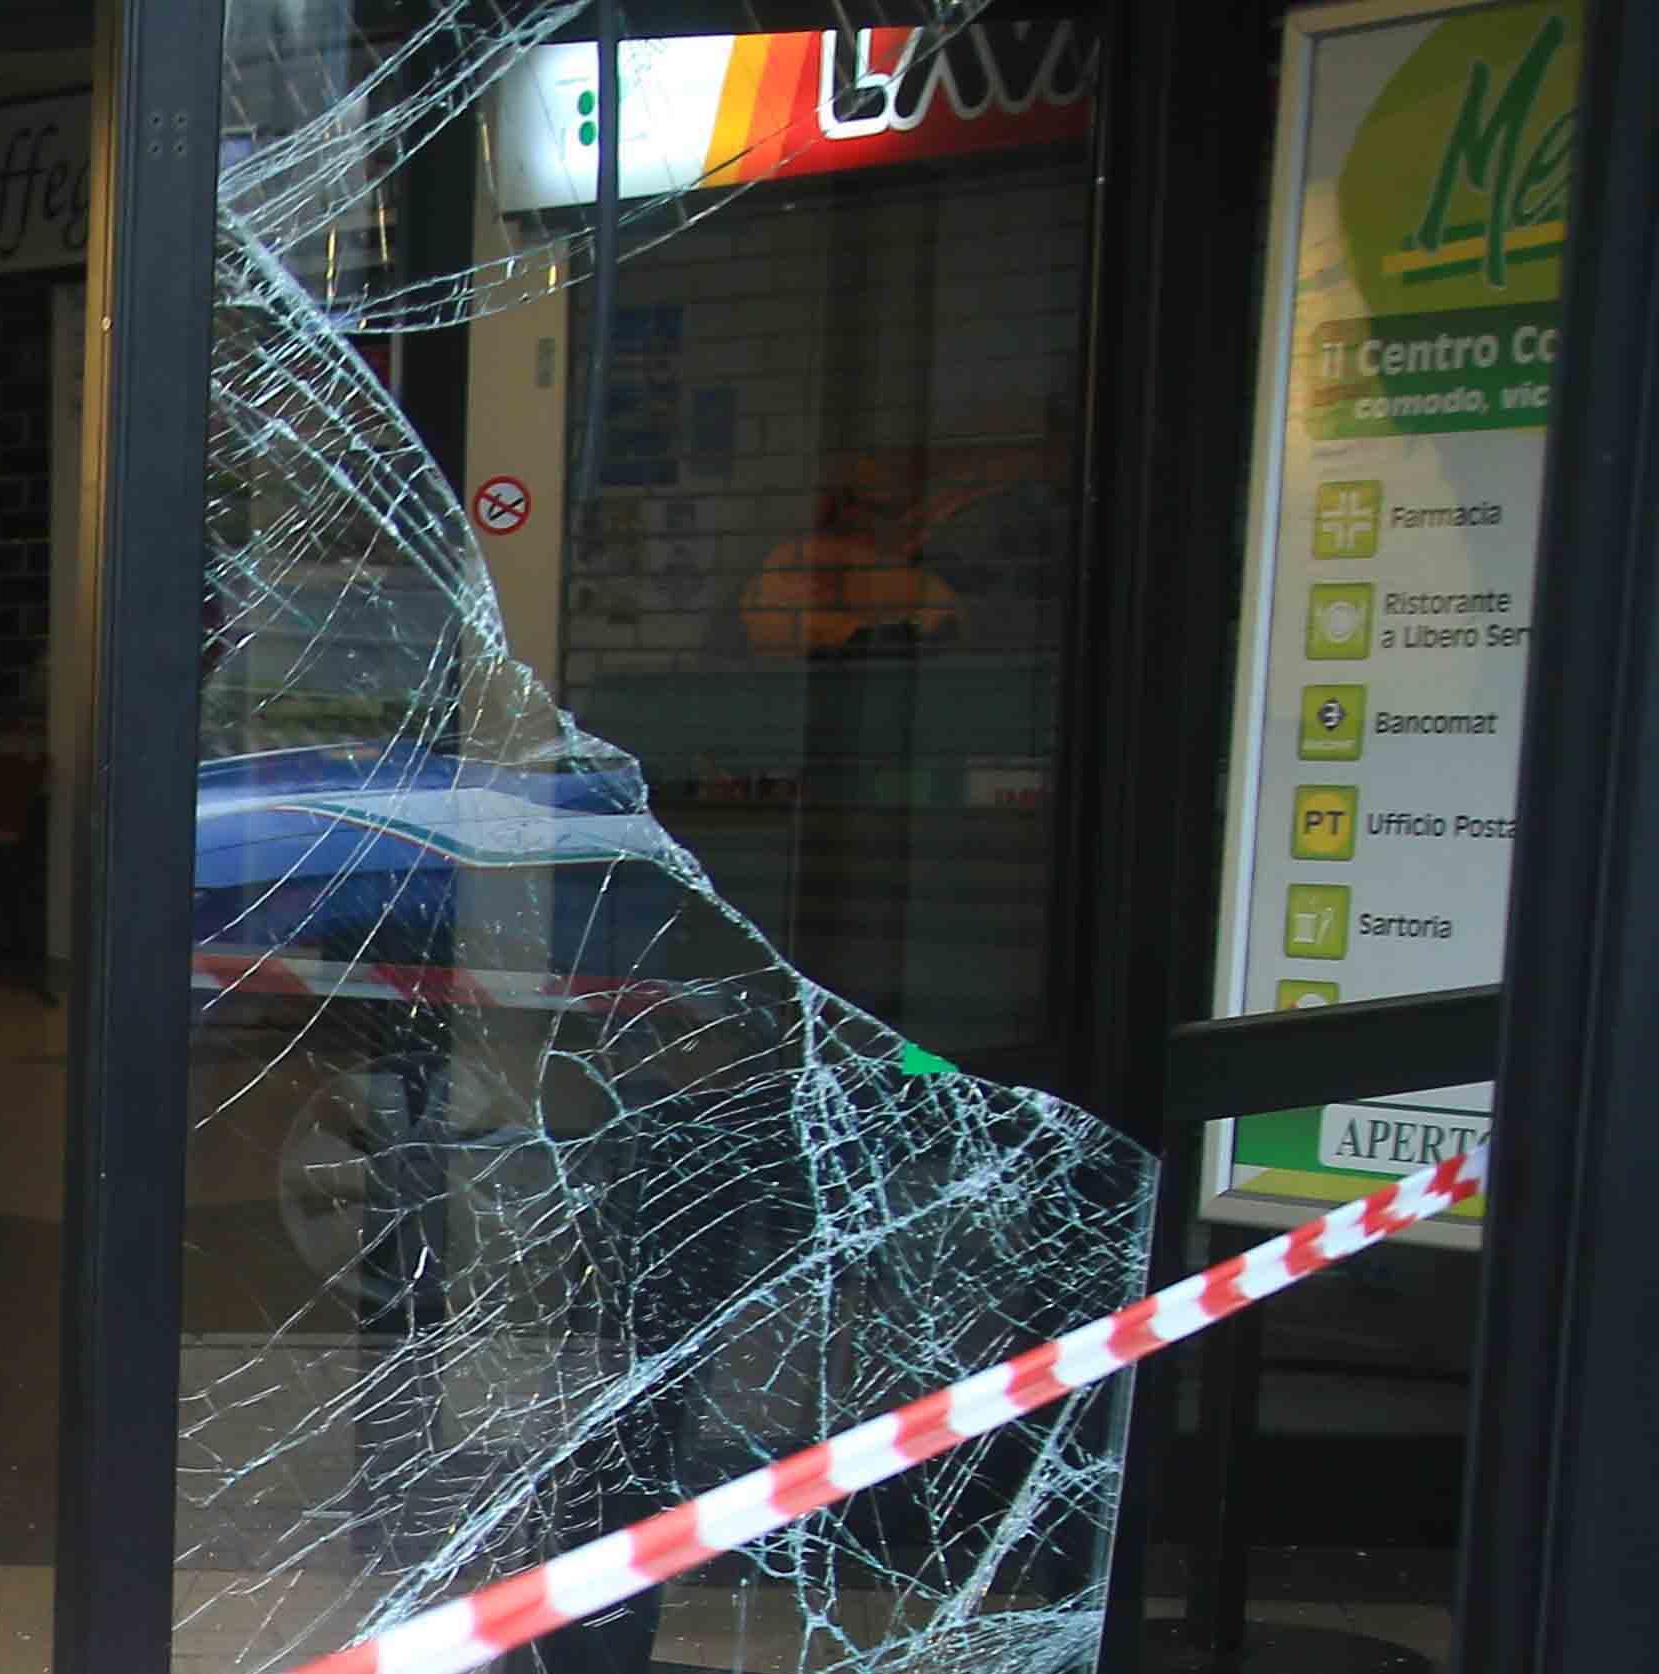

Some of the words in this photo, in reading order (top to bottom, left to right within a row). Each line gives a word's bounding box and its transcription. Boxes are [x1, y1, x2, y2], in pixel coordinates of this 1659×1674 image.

[1357, 332, 1500, 376] Centro
[1354, 386, 1489, 419] comodo,
[1391, 502, 1501, 528] Farmacia
[1386, 589, 1512, 615] Ristorante
[1382, 630, 1394, 648] a
[1404, 625, 1479, 648] Libero
[1375, 711, 1499, 735] Bancomat
[1304, 810, 1345, 836] PT
[1367, 813, 1447, 837] Ufficio
[1357, 913, 1452, 939] Sartoria
